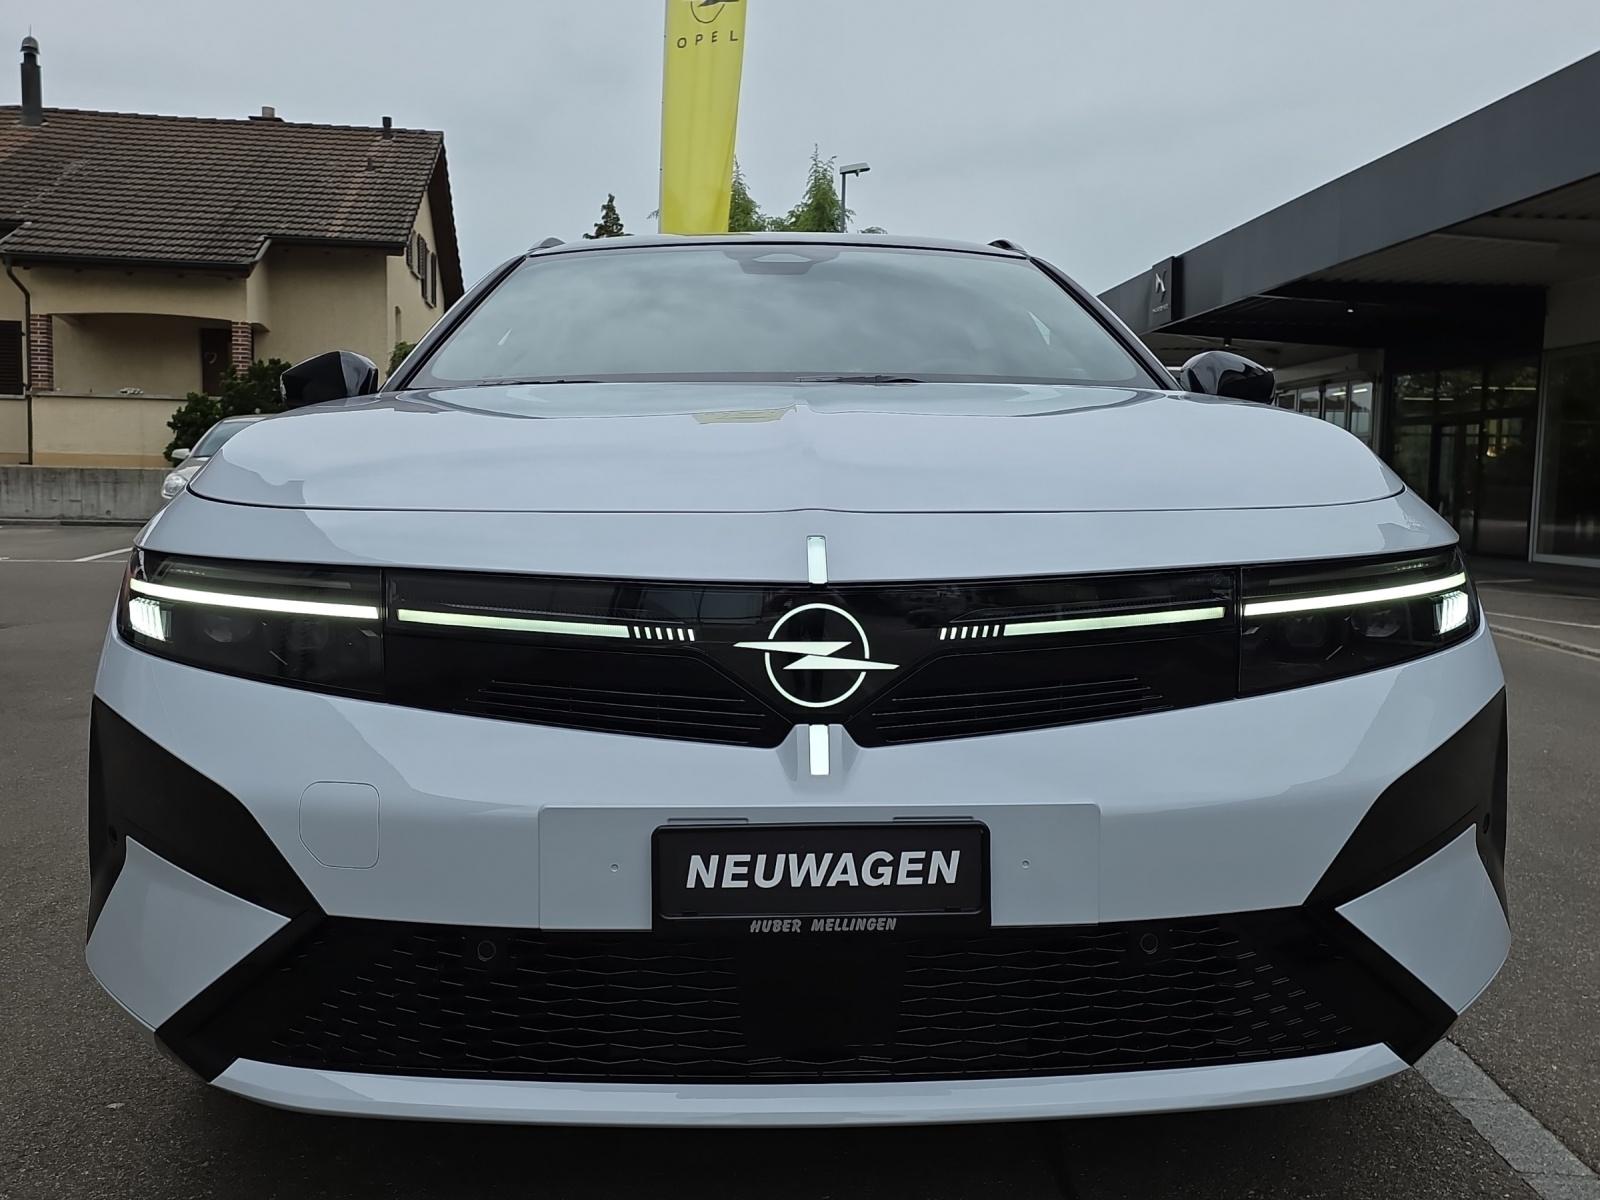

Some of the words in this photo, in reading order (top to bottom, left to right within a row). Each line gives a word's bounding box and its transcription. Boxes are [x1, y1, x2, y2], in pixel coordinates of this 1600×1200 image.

[677, 30, 739, 49] OPEL
[686, 850, 961, 889] NEUWAGEN
[749, 919, 802, 934] HUBER
[810, 917, 897, 932] MELLINGEN
